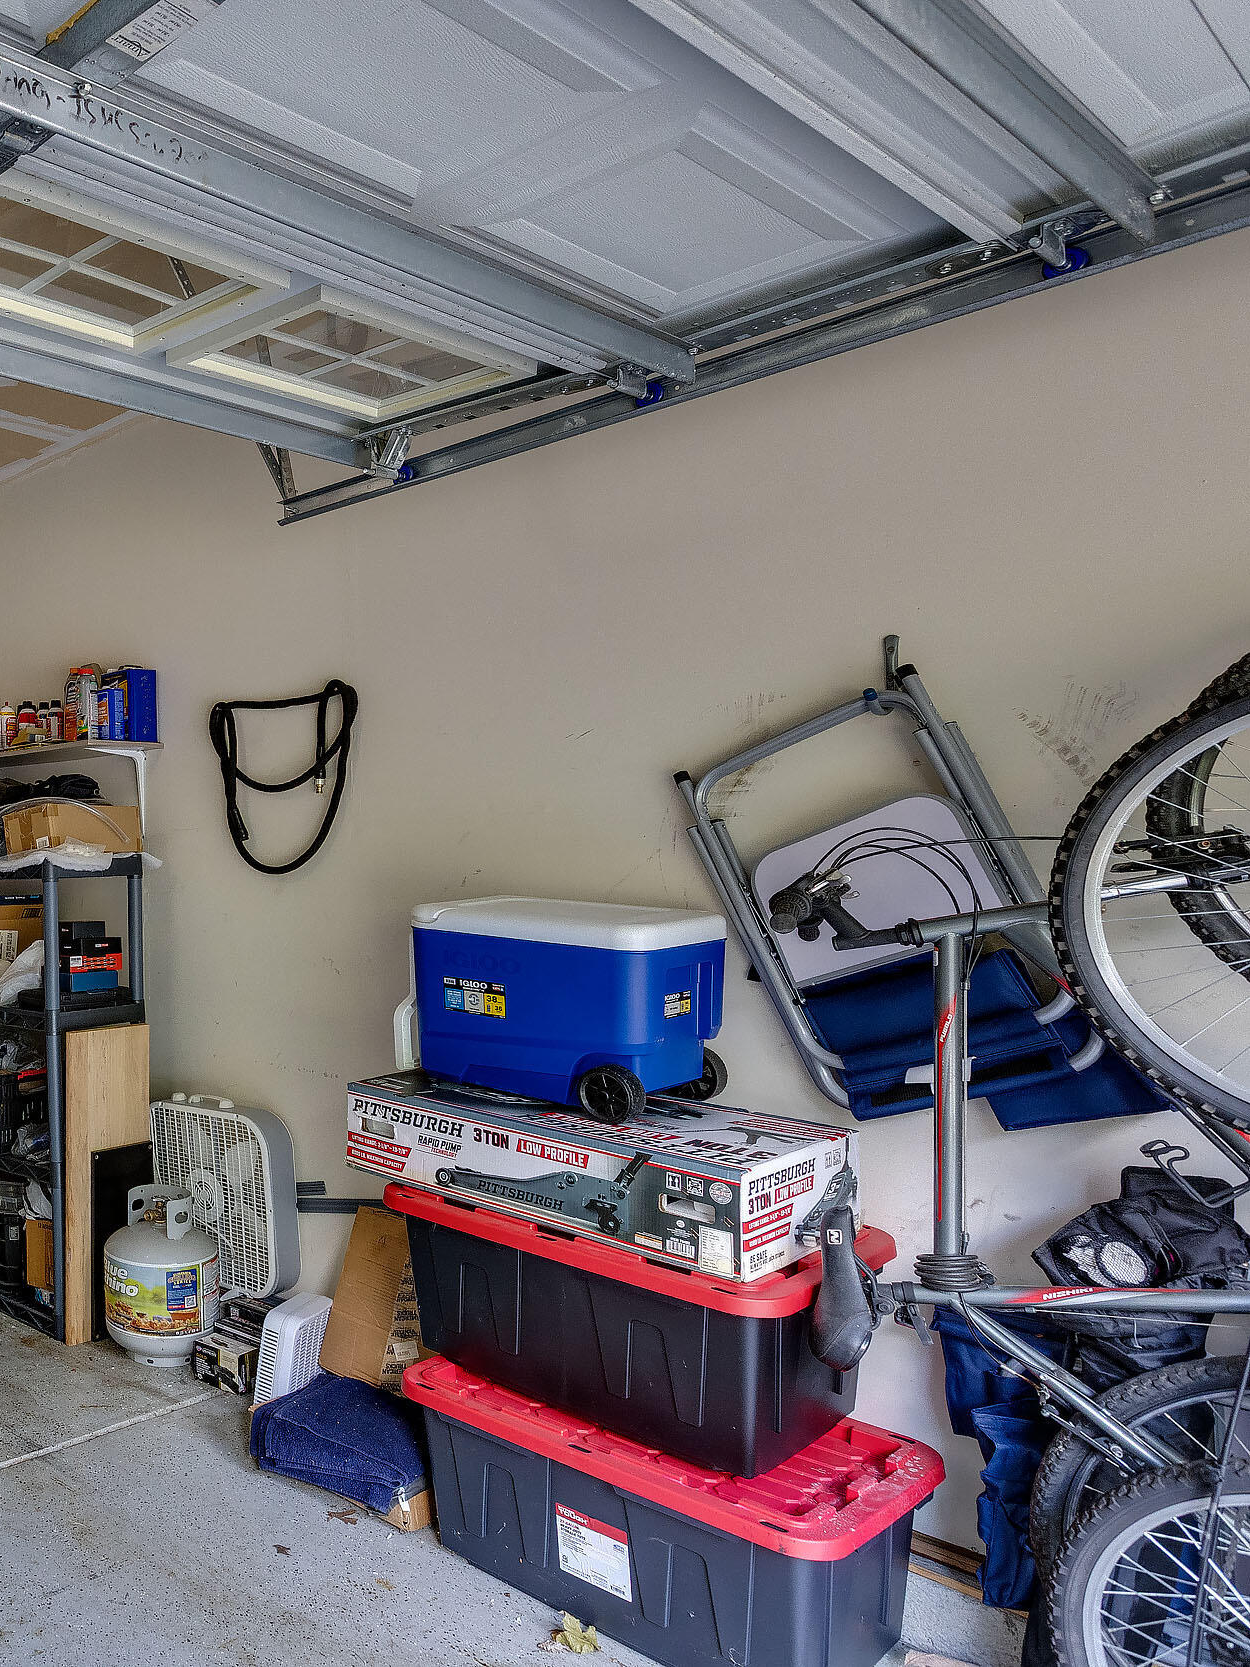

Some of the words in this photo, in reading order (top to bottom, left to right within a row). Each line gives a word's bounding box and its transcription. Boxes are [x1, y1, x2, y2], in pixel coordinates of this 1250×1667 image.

[459, 979, 488, 990] IGLOO
[939, 1013, 953, 1043] PUEBLO
[352, 1098, 466, 1139] PITTSBURGH
[417, 1134, 440, 1148] RAPID
[440, 1139, 463, 1153] PUMP
[520, 1139, 543, 1157] LOW
[543, 1145, 586, 1167] PROFILE
[748, 1157, 816, 1196] PITTSBURGH
[476, 1179, 565, 1211] PITTSBURGH
[104, 1276, 139, 1298] hino
[1042, 1287, 1094, 1301] NISHIKI
